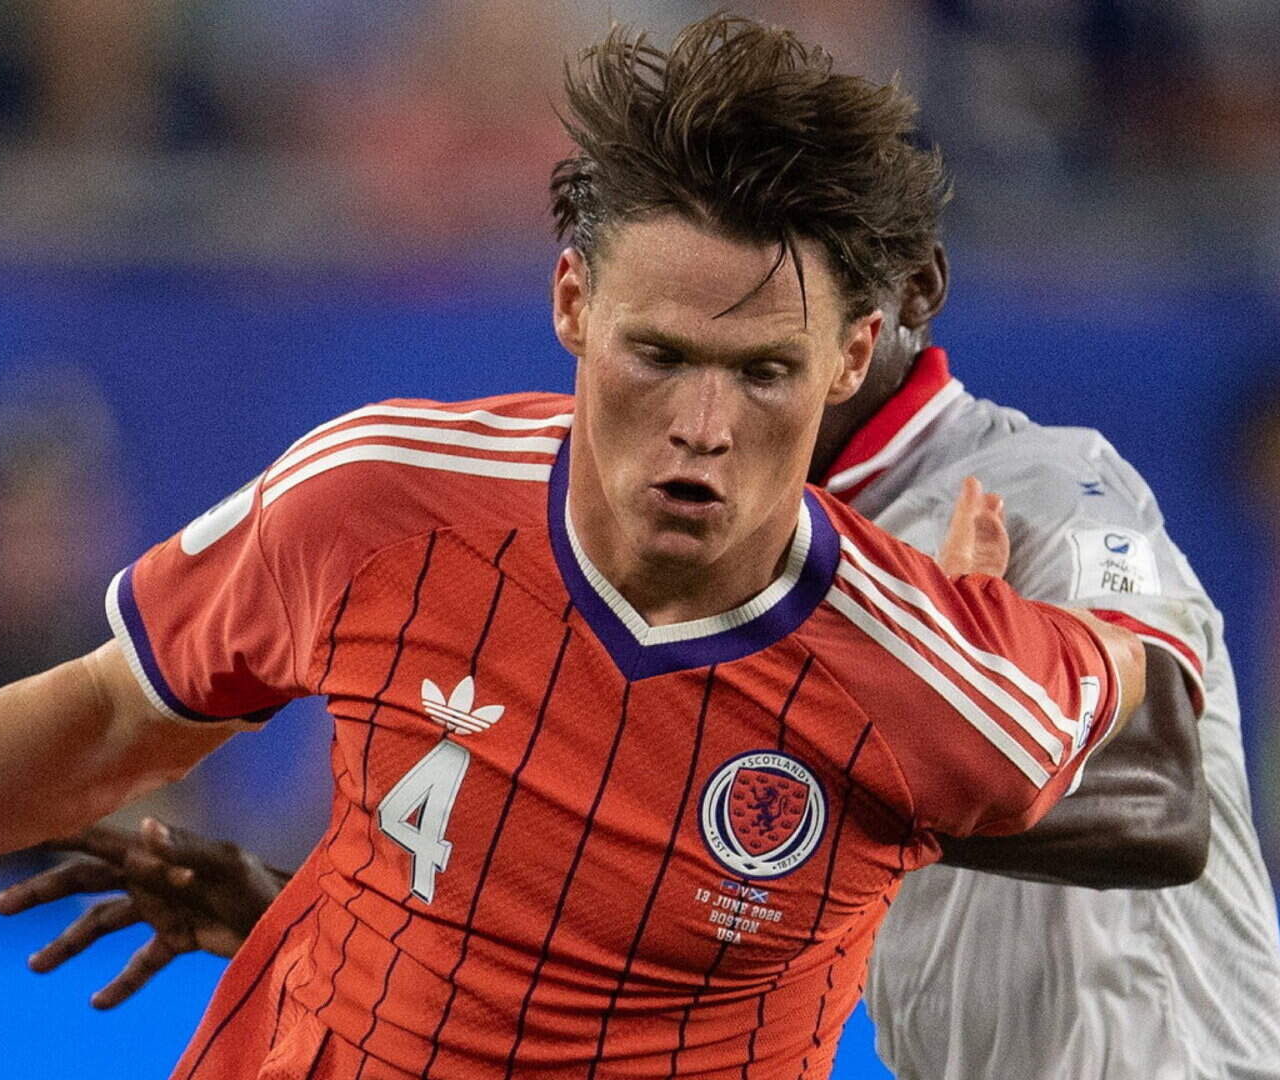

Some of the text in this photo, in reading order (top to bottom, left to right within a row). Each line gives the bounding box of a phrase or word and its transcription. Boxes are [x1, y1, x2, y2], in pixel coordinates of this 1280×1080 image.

[748, 756, 806, 779] SCOTLAND
[376, 739, 471, 905] 4
[777, 854, 798, 870] 1873
[712, 895, 749, 915] JUNE
[709, 909, 760, 933] BOSTON
[716, 927, 742, 944] USA
